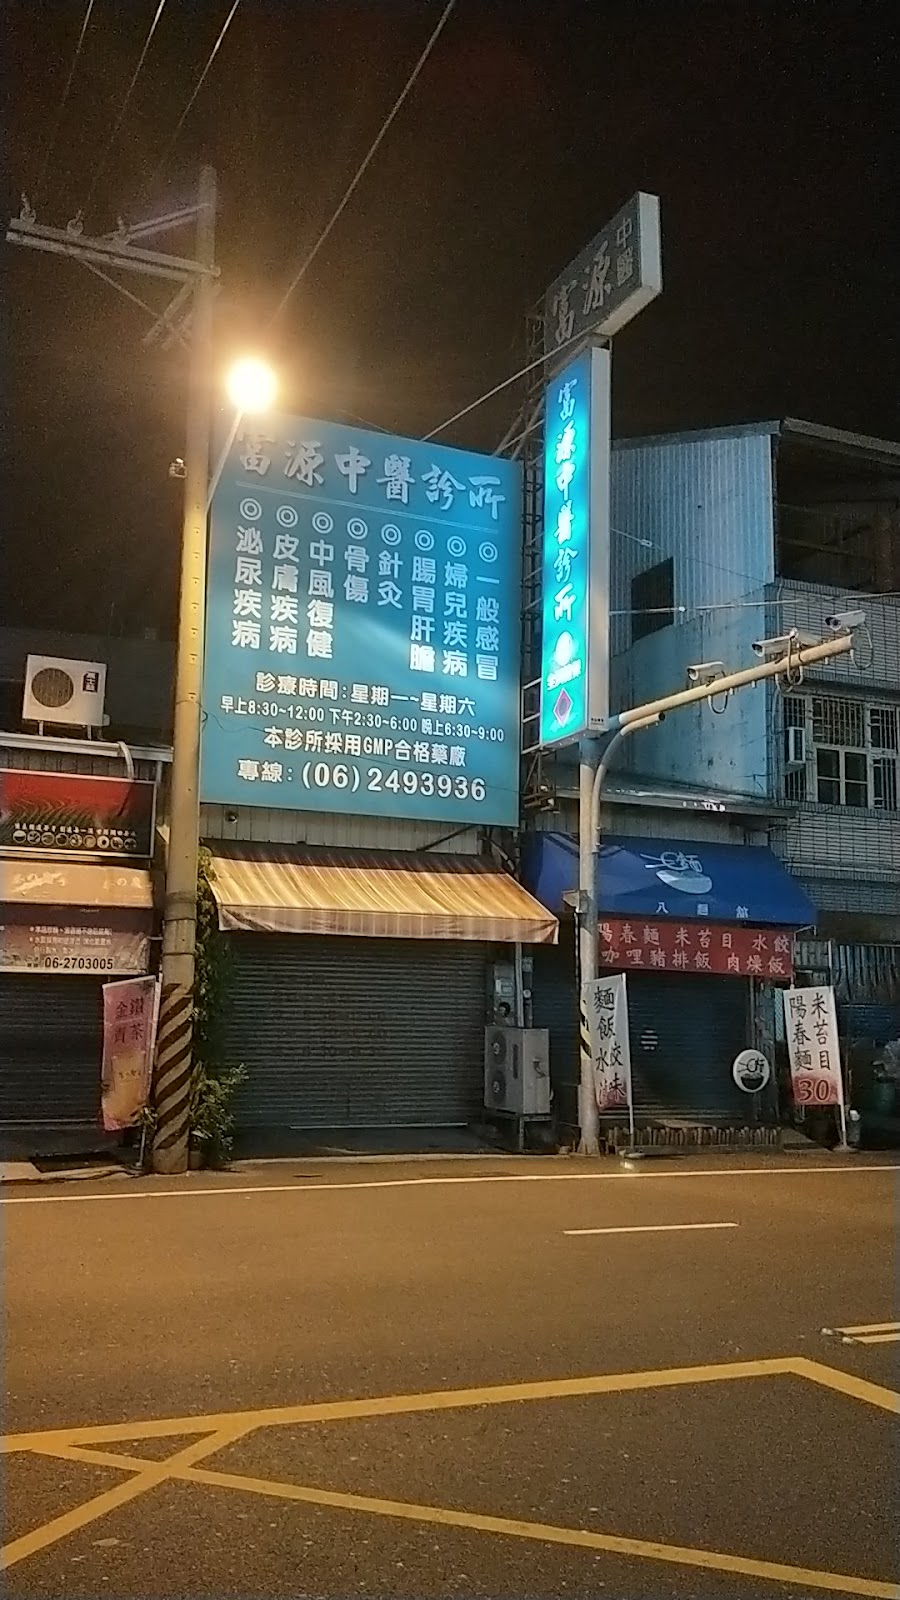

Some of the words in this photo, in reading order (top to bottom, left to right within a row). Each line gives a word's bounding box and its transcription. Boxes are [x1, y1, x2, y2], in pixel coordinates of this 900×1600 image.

[236, 431, 506, 520] 富源中醫診所
[231, 525, 264, 650] 泌尿疾病
[269, 533, 299, 655] 皮膚疾病
[306, 539, 335, 660] 中風復健
[343, 544, 370, 604] 骨傷
[409, 555, 437, 673] 腸胃肝膽
[442, 561, 469, 677] 婦兒疾病
[475, 574, 500, 681] 一般感冒
[44, 956, 114, 970] 06-2703005
[601, 946, 713, 970] 咖哩豬排飯
[751, 933, 791, 954] 水餃
[788, 994, 814, 1072] 陽春麵
[798, 1079, 831, 1101] 30
